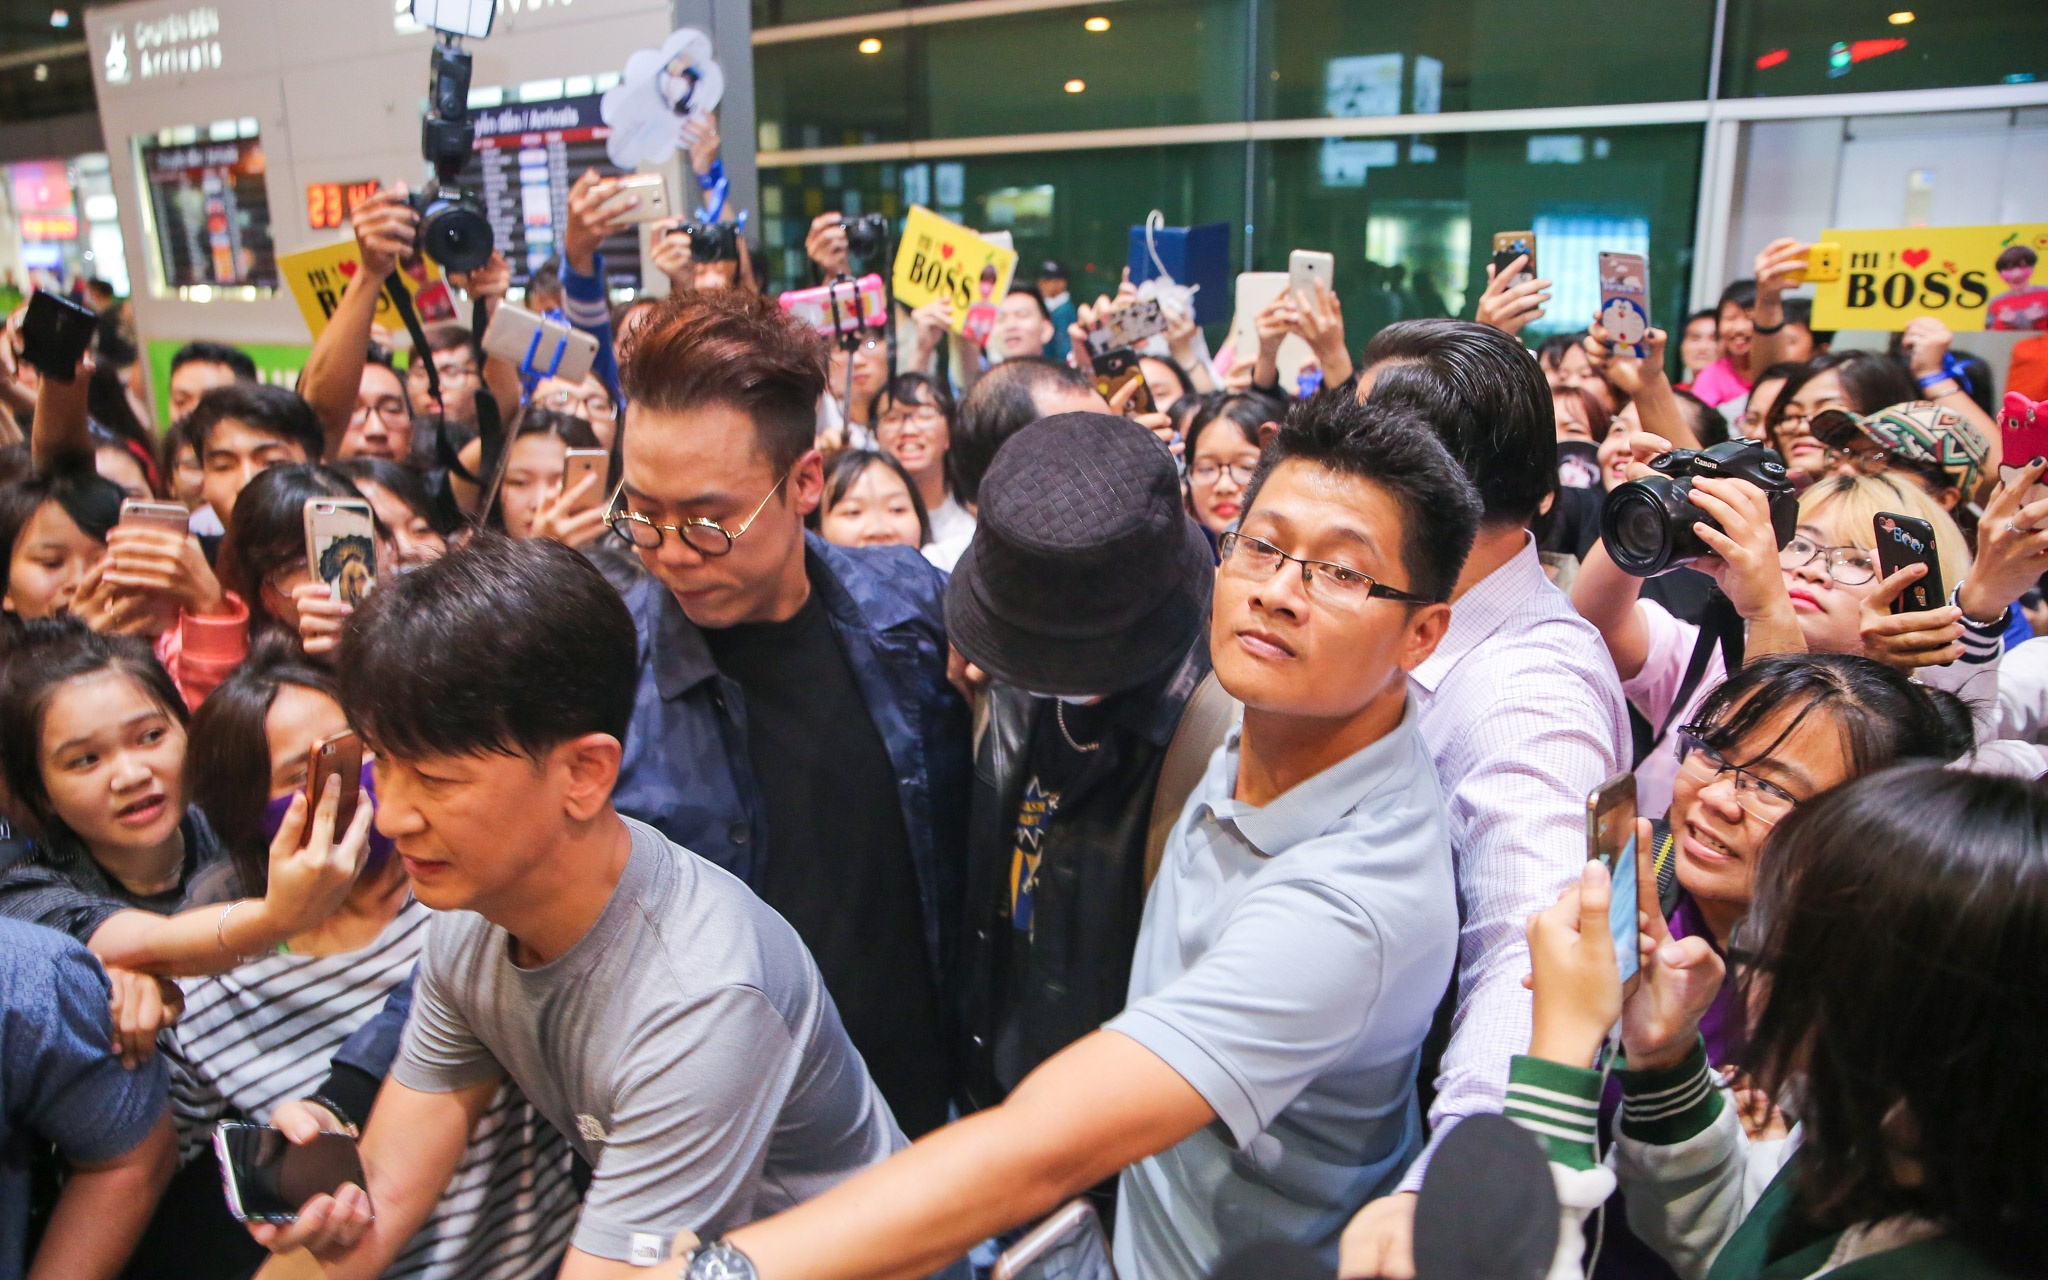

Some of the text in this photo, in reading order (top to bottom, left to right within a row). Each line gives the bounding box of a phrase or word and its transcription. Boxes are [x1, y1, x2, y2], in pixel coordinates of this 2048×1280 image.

[1850, 251, 1879, 269] HI
[910, 252, 973, 310] BOSS
[1847, 271, 1989, 309] BOSS
[1694, 457, 1718, 469] Canon
